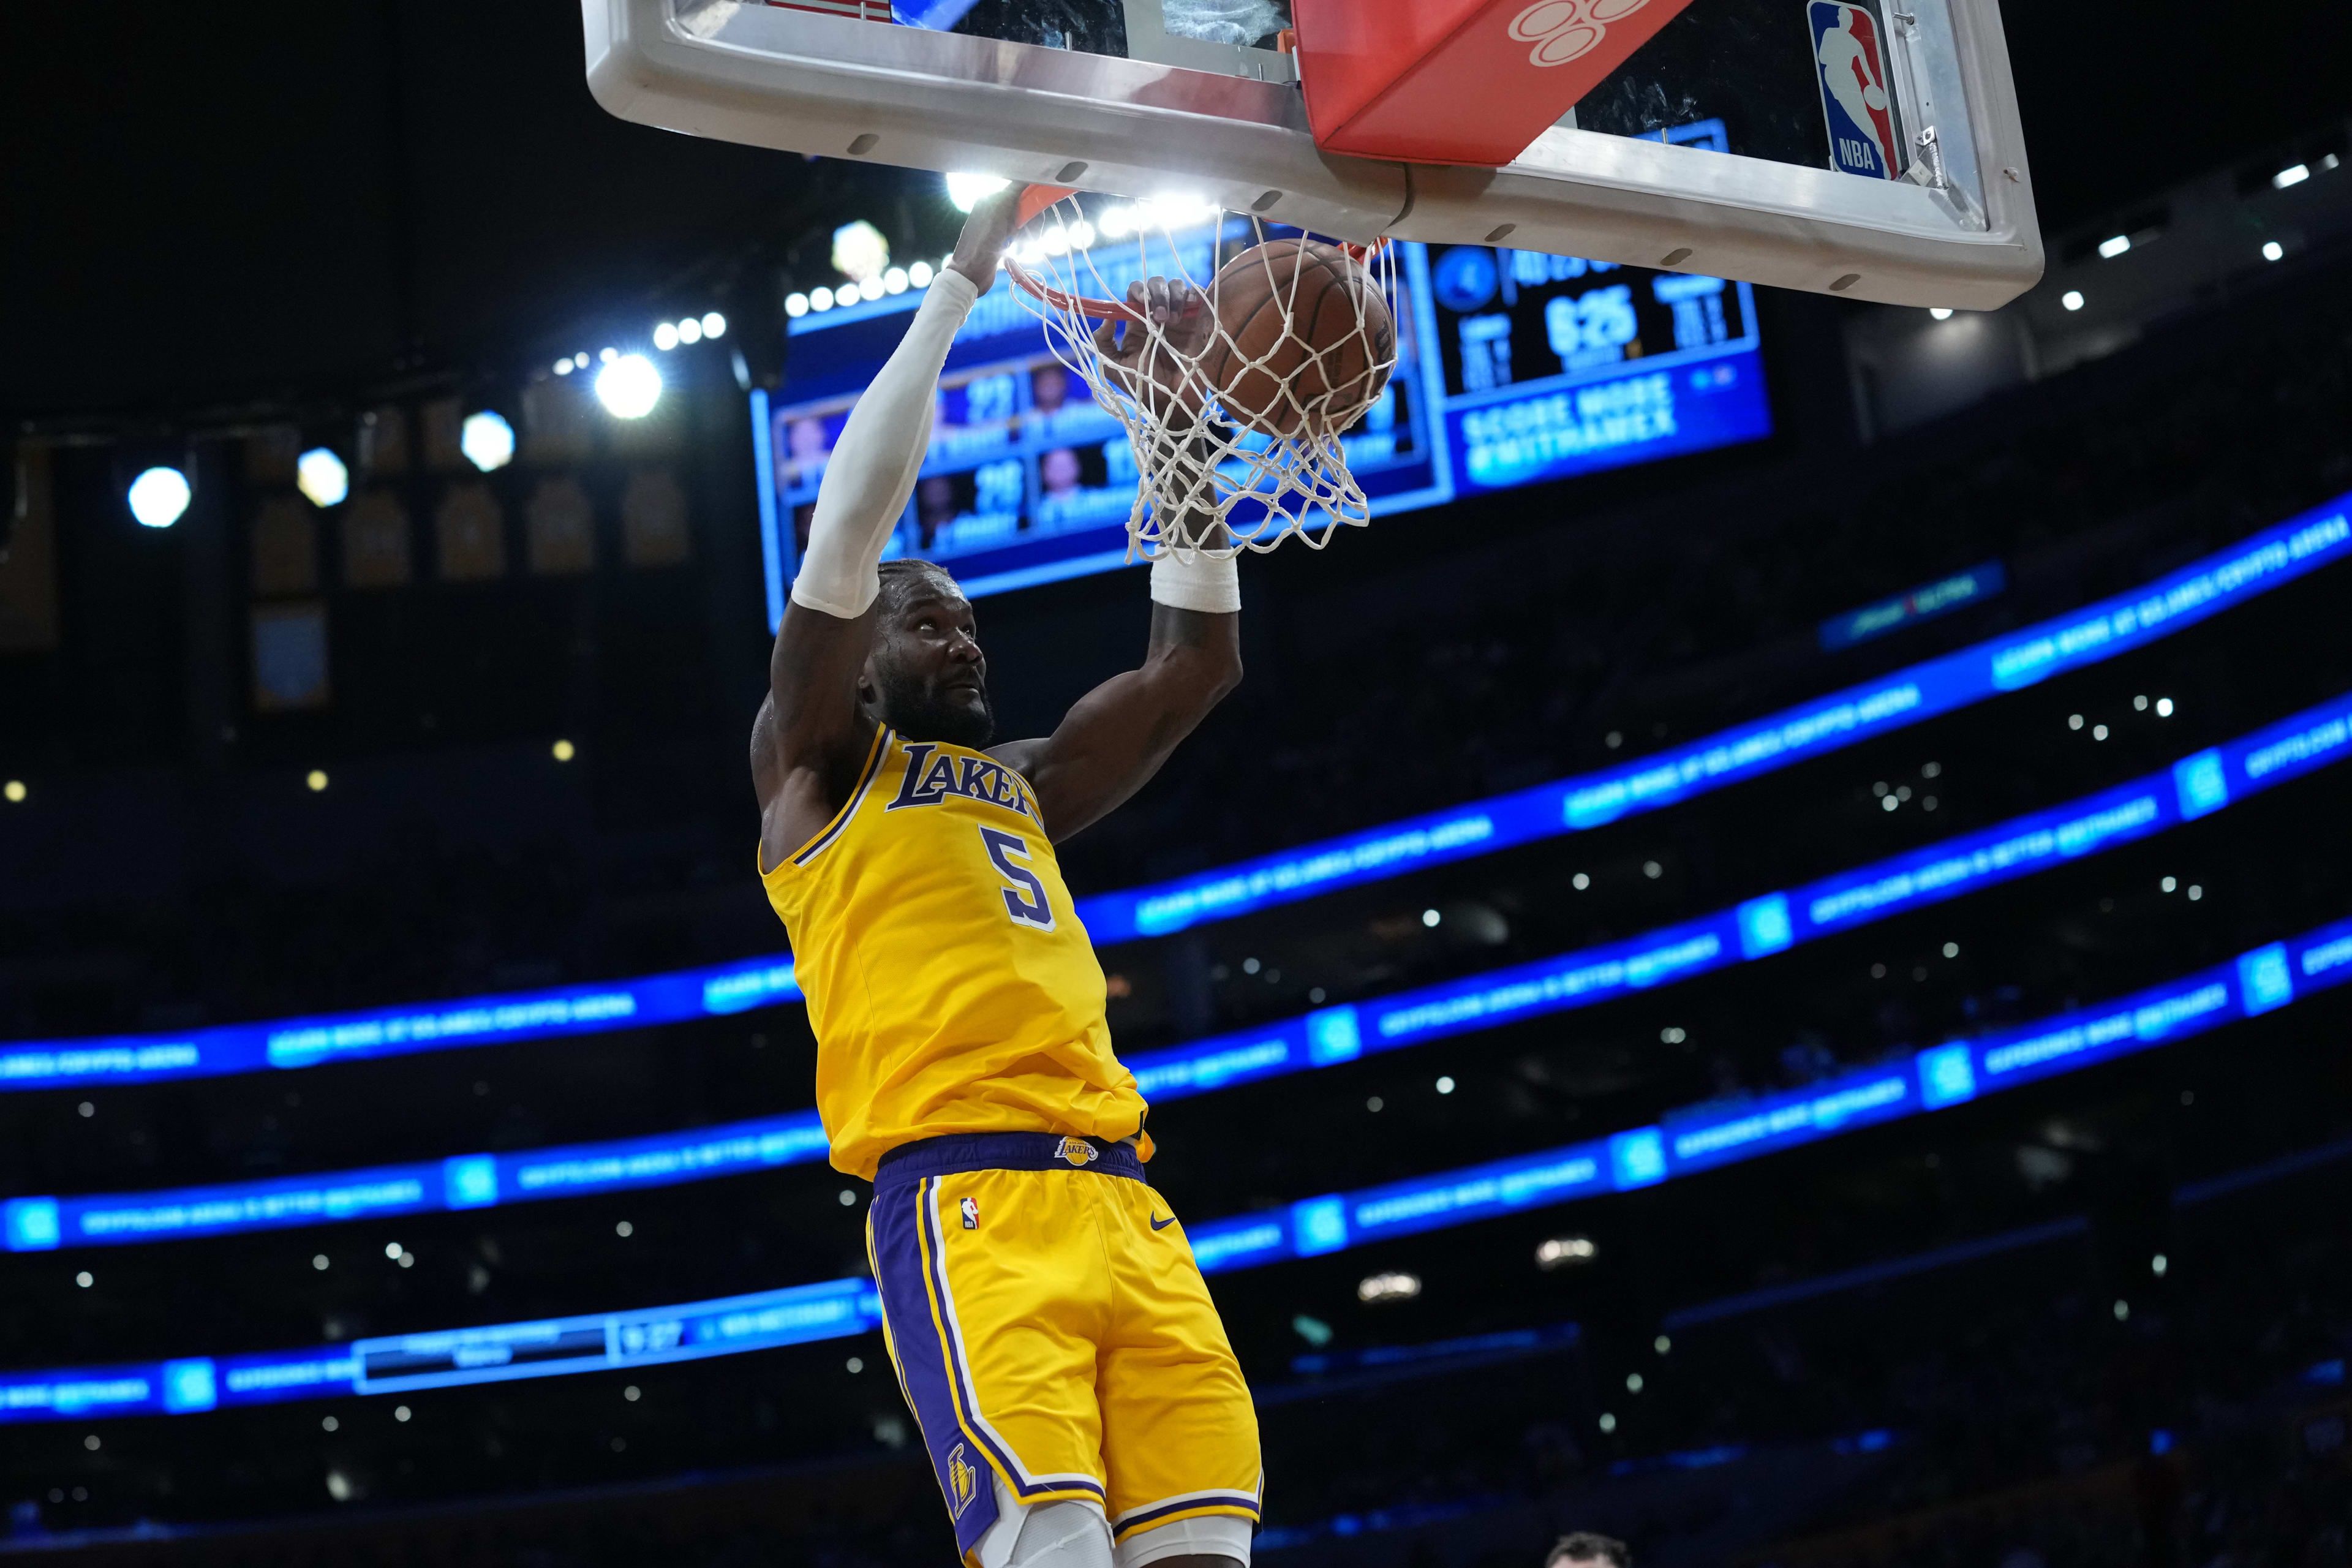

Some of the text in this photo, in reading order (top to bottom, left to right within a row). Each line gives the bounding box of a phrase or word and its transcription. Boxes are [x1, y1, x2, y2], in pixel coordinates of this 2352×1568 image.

[1839, 138, 1875, 170] NBA
[977, 823, 1057, 933] 5
[1055, 1140, 1097, 1159] LAKERS
